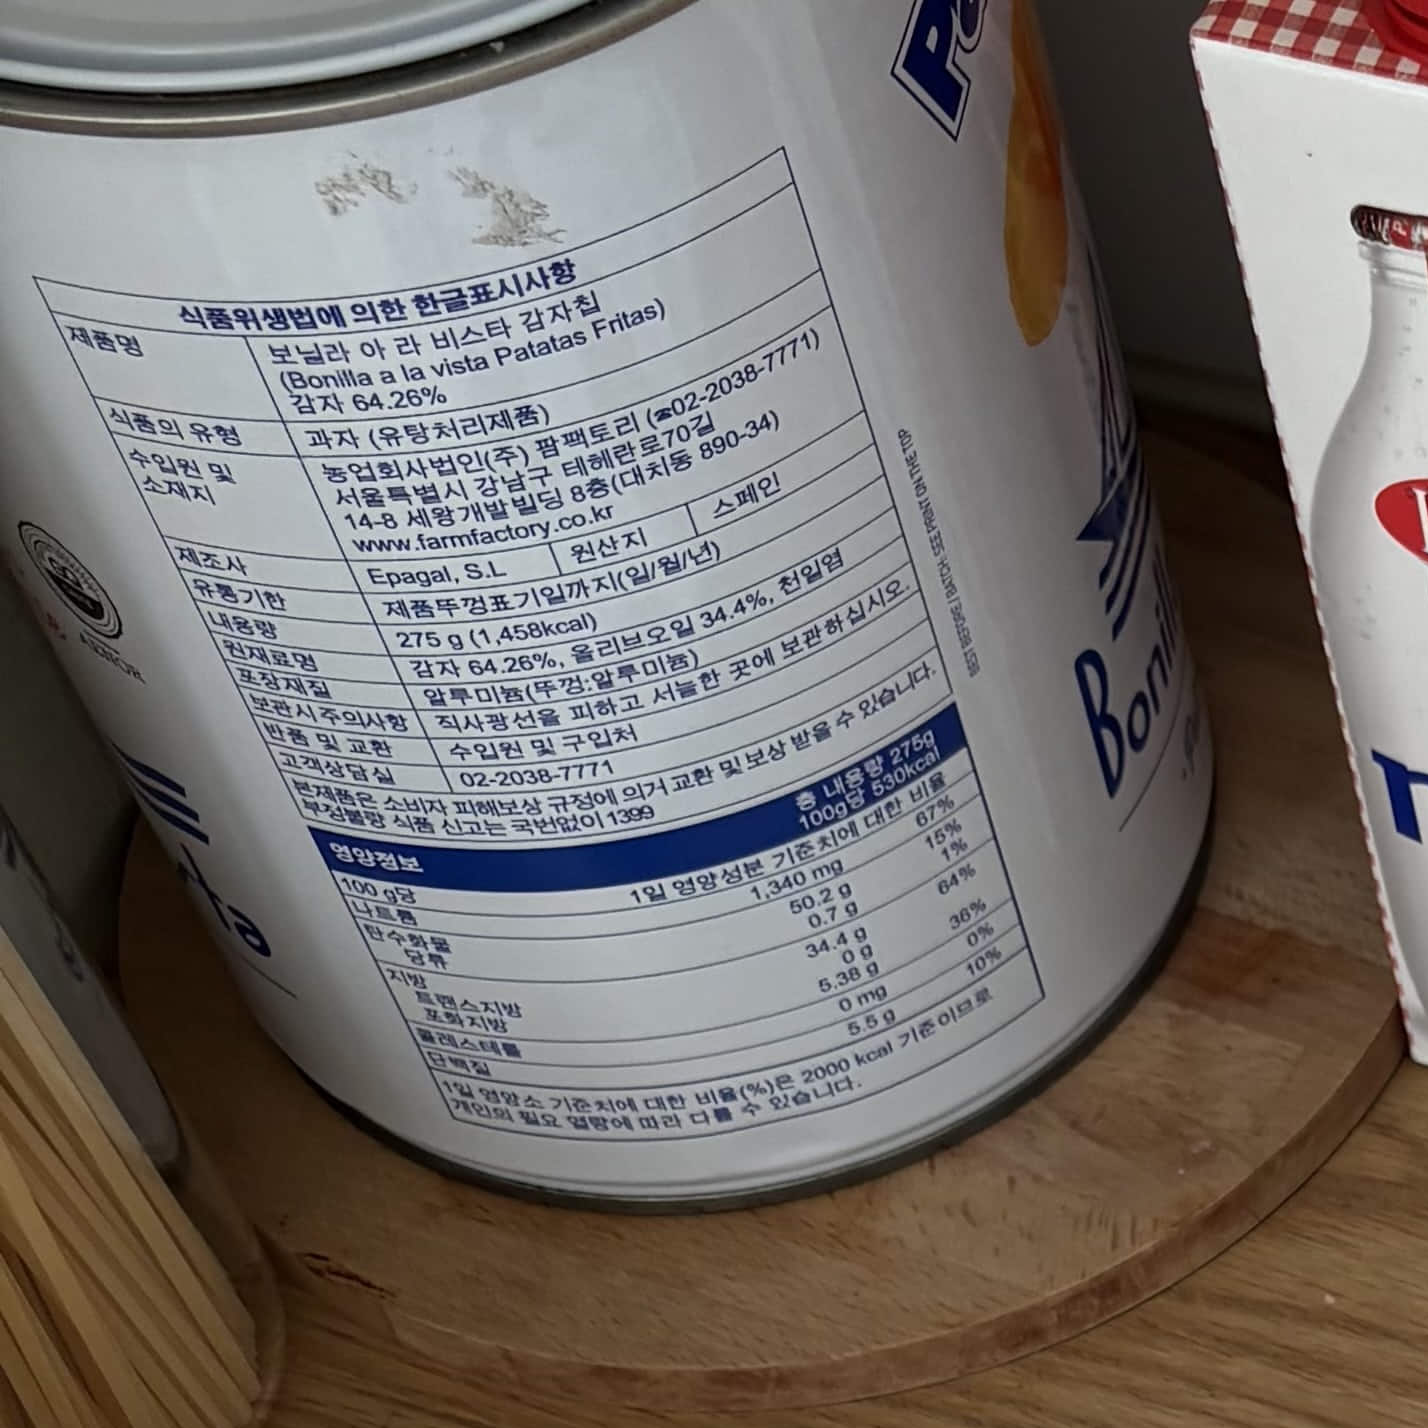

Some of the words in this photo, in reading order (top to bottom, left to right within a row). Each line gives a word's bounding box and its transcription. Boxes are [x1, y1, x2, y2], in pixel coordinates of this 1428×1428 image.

[178, 304, 348, 332] 식품위생법에
[351, 297, 407, 327] 의한
[414, 258, 576, 318] 한글표시사항
[65, 325, 145, 357] 제품명
[269, 339, 350, 364] 보닐라
[362, 337, 386, 360] 아
[397, 331, 422, 358] 라
[430, 313, 512, 351] 비스타
[519, 290, 602, 340] 감자칩
[280, 365, 374, 396] (Bonilla
[379, 367, 397, 385] a
[402, 359, 426, 383] la
[430, 343, 491, 379] vista
[494, 321, 588, 369] Patatas
[592, 297, 667, 343] Fritas)
[291, 392, 344, 416] 감자
[352, 385, 447, 411] 64.26%
[110, 406, 184, 440] 식품의
[190, 422, 242, 446] 유형
[308, 427, 361, 451] 과자
[369, 402, 552, 453] (유탕처리제품)
[129, 448, 202, 479] 수입원
[208, 461, 237, 484] 및
[323, 444, 530, 486] 농업회사법인(주)
[535, 412, 639, 461] 팜팩토리
[336, 477, 470, 509] 서울특별시
[474, 465, 553, 498] 강남구
[561, 410, 716, 479] 테헤란로70길
[344, 510, 399, 531] 14-8
[570, 443, 694, 504] 8층(대치동
[699, 408, 781, 462] 890-34)
[143, 475, 217, 506] 소재지
[712, 471, 782, 520] 스페인
[352, 502, 615, 553] www.farmfactory.co.kr
[570, 528, 648, 565] 원산지
[174, 545, 248, 576] 제조사
[367, 564, 460, 590] Epagal,
[463, 560, 508, 581] S.L
[193, 578, 287, 613] 유통기한
[410, 658, 462, 680] 감자
[467, 651, 566, 676] 64.26%,
[571, 613, 695, 663] 올리브오일
[699, 591, 775, 630] 34.4%,
[778, 549, 845, 595] 천일염
[208, 609, 279, 640] 내용량
[396, 631, 441, 649] 275
[447, 634, 465, 652] g
[468, 613, 598, 649] (1,458kcal)
[889, 728, 936, 763] 275g
[458, 759, 616, 788] 02-2038-7771
[870, 746, 941, 798] 530kcal
